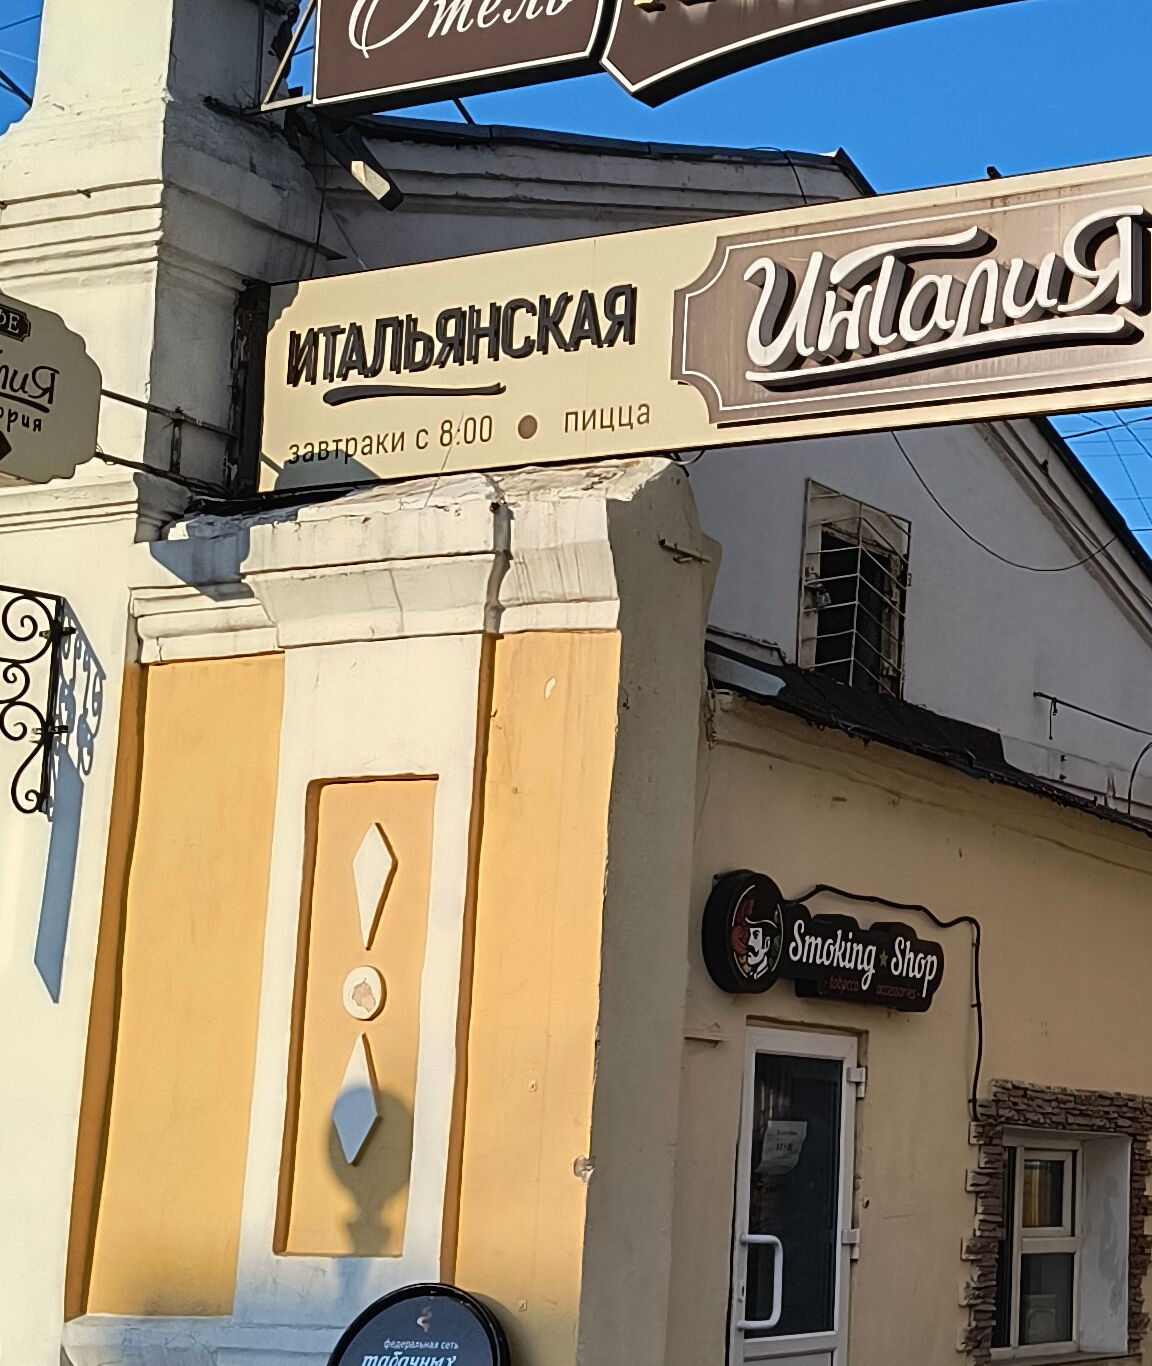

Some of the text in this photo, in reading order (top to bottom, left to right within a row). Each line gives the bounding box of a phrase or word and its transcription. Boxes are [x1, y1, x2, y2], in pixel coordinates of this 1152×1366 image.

[285, 283, 638, 388] ИТАЛЬЯНСКАЯ
[287, 403, 652, 466] завтраки с 8:00 пицца
[788, 919, 939, 998] Smoking Shop
[383, 1338, 459, 1350] федеральная сеть
